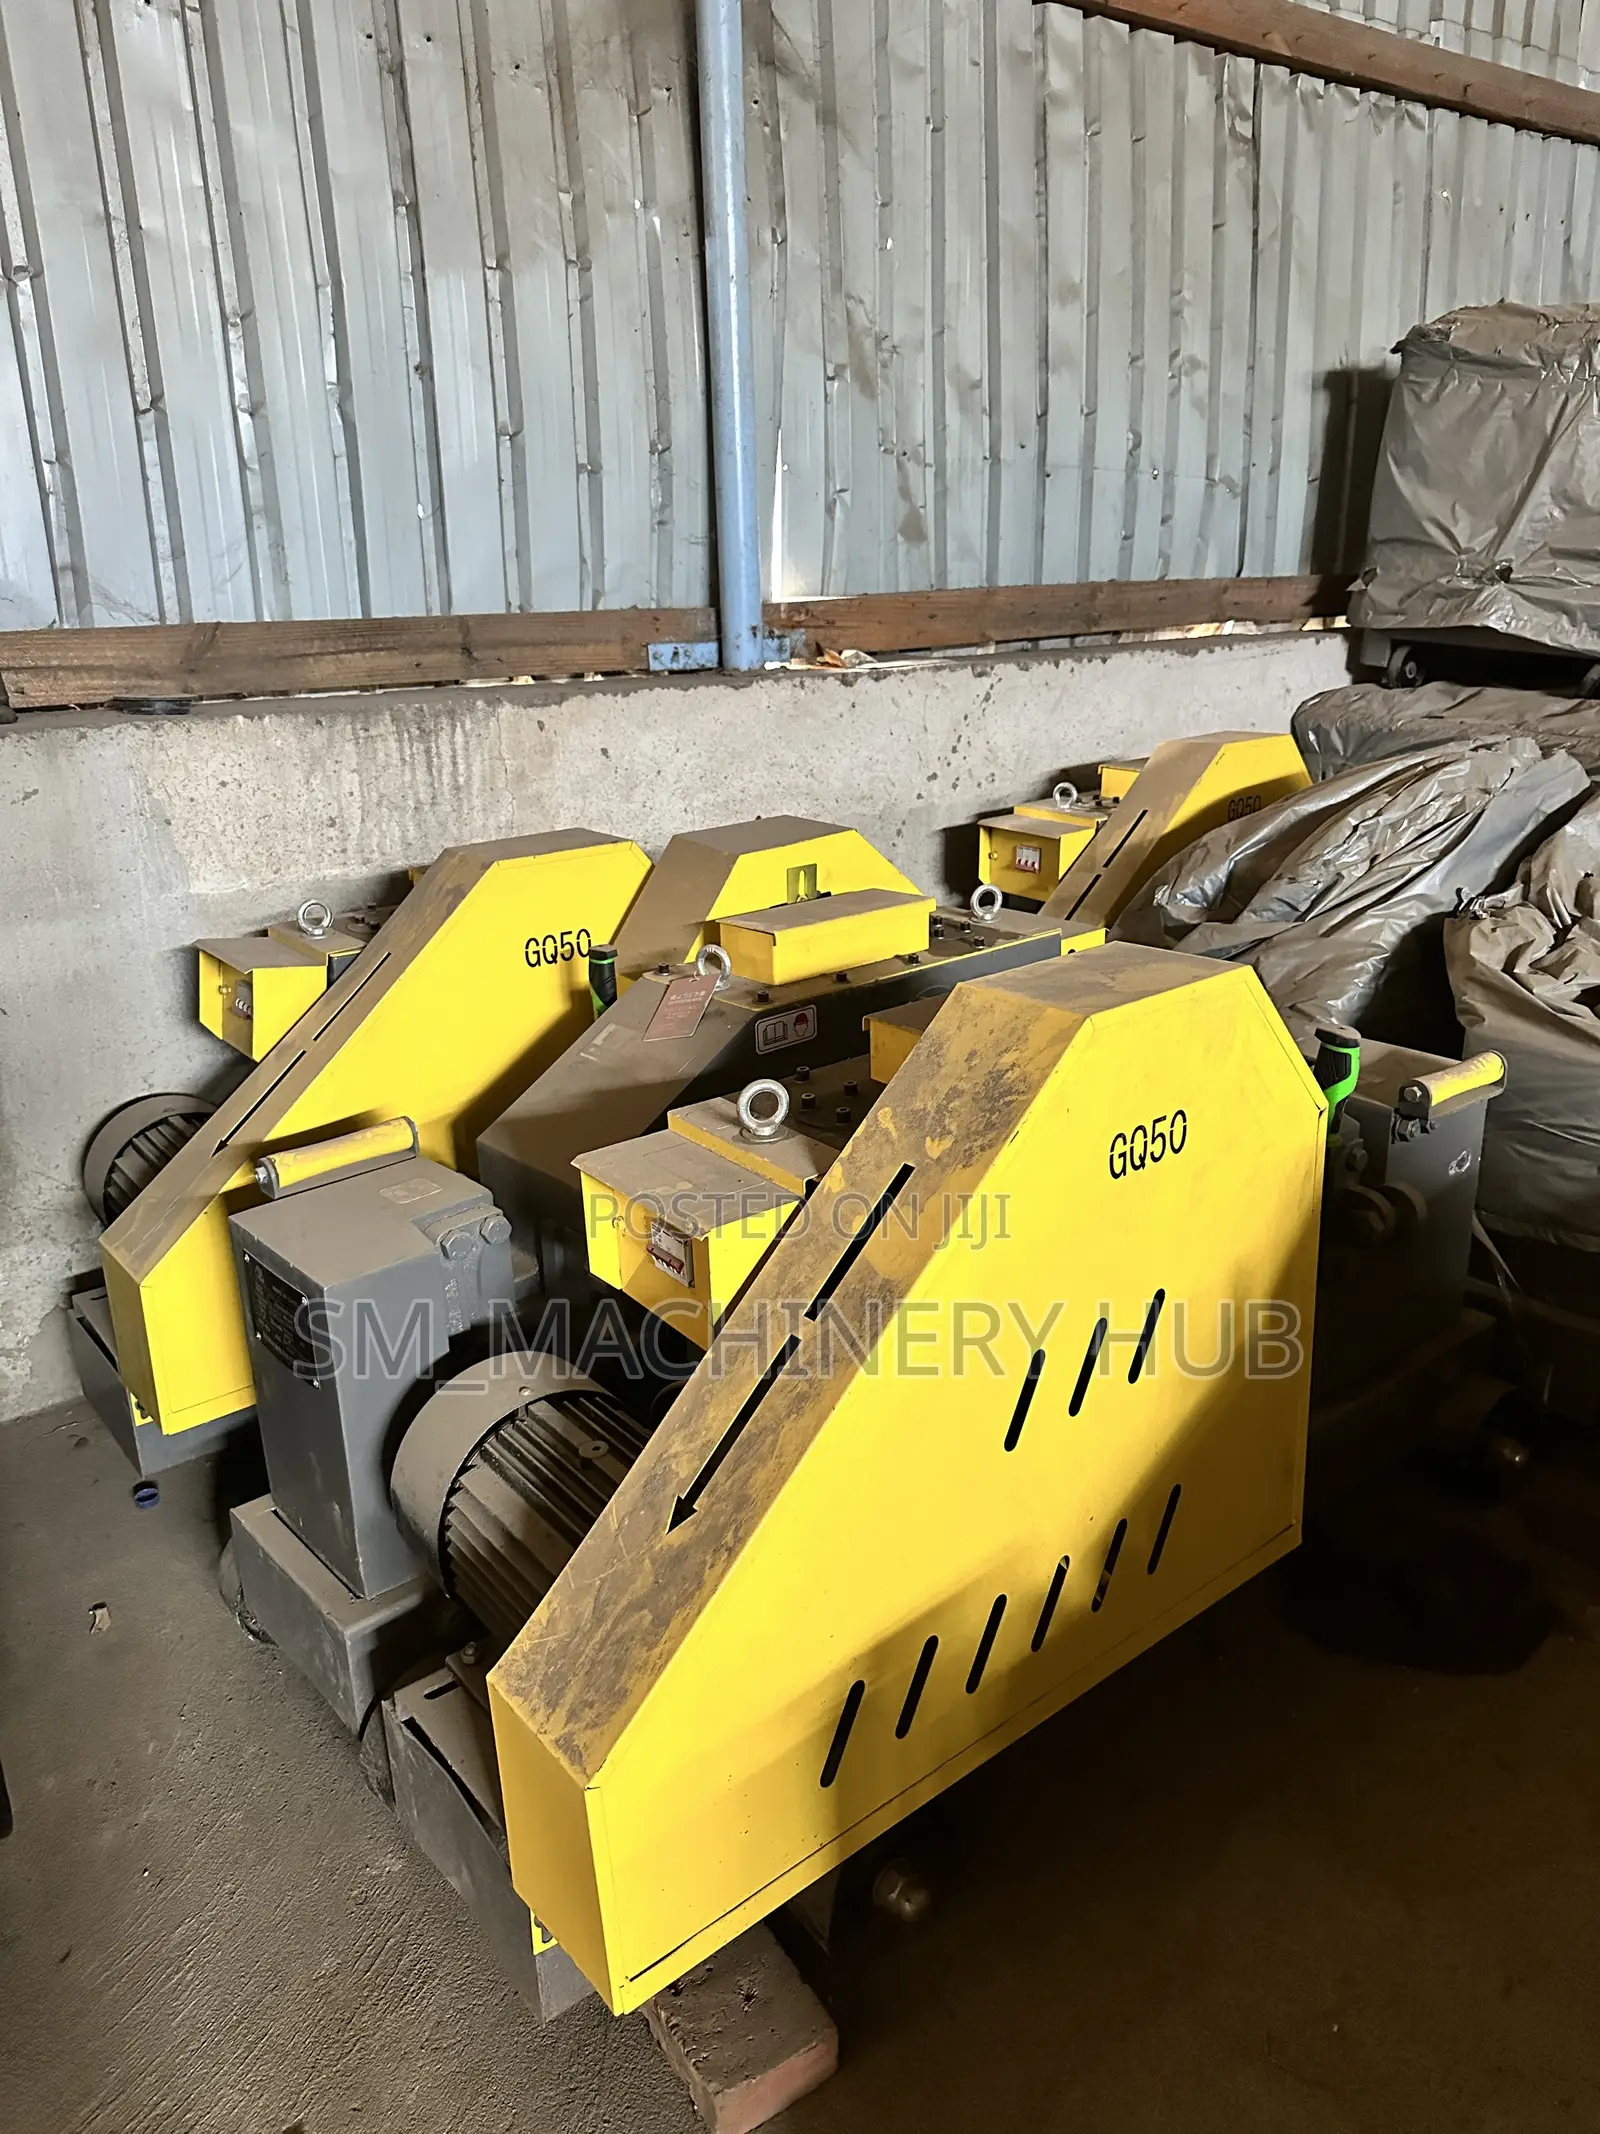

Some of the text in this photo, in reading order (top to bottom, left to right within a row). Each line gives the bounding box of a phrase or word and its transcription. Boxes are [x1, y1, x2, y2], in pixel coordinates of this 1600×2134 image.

[1228, 795, 1261, 822] GQ50
[524, 928, 592, 968] GQ50
[1109, 1109, 1187, 1180] GQ50
